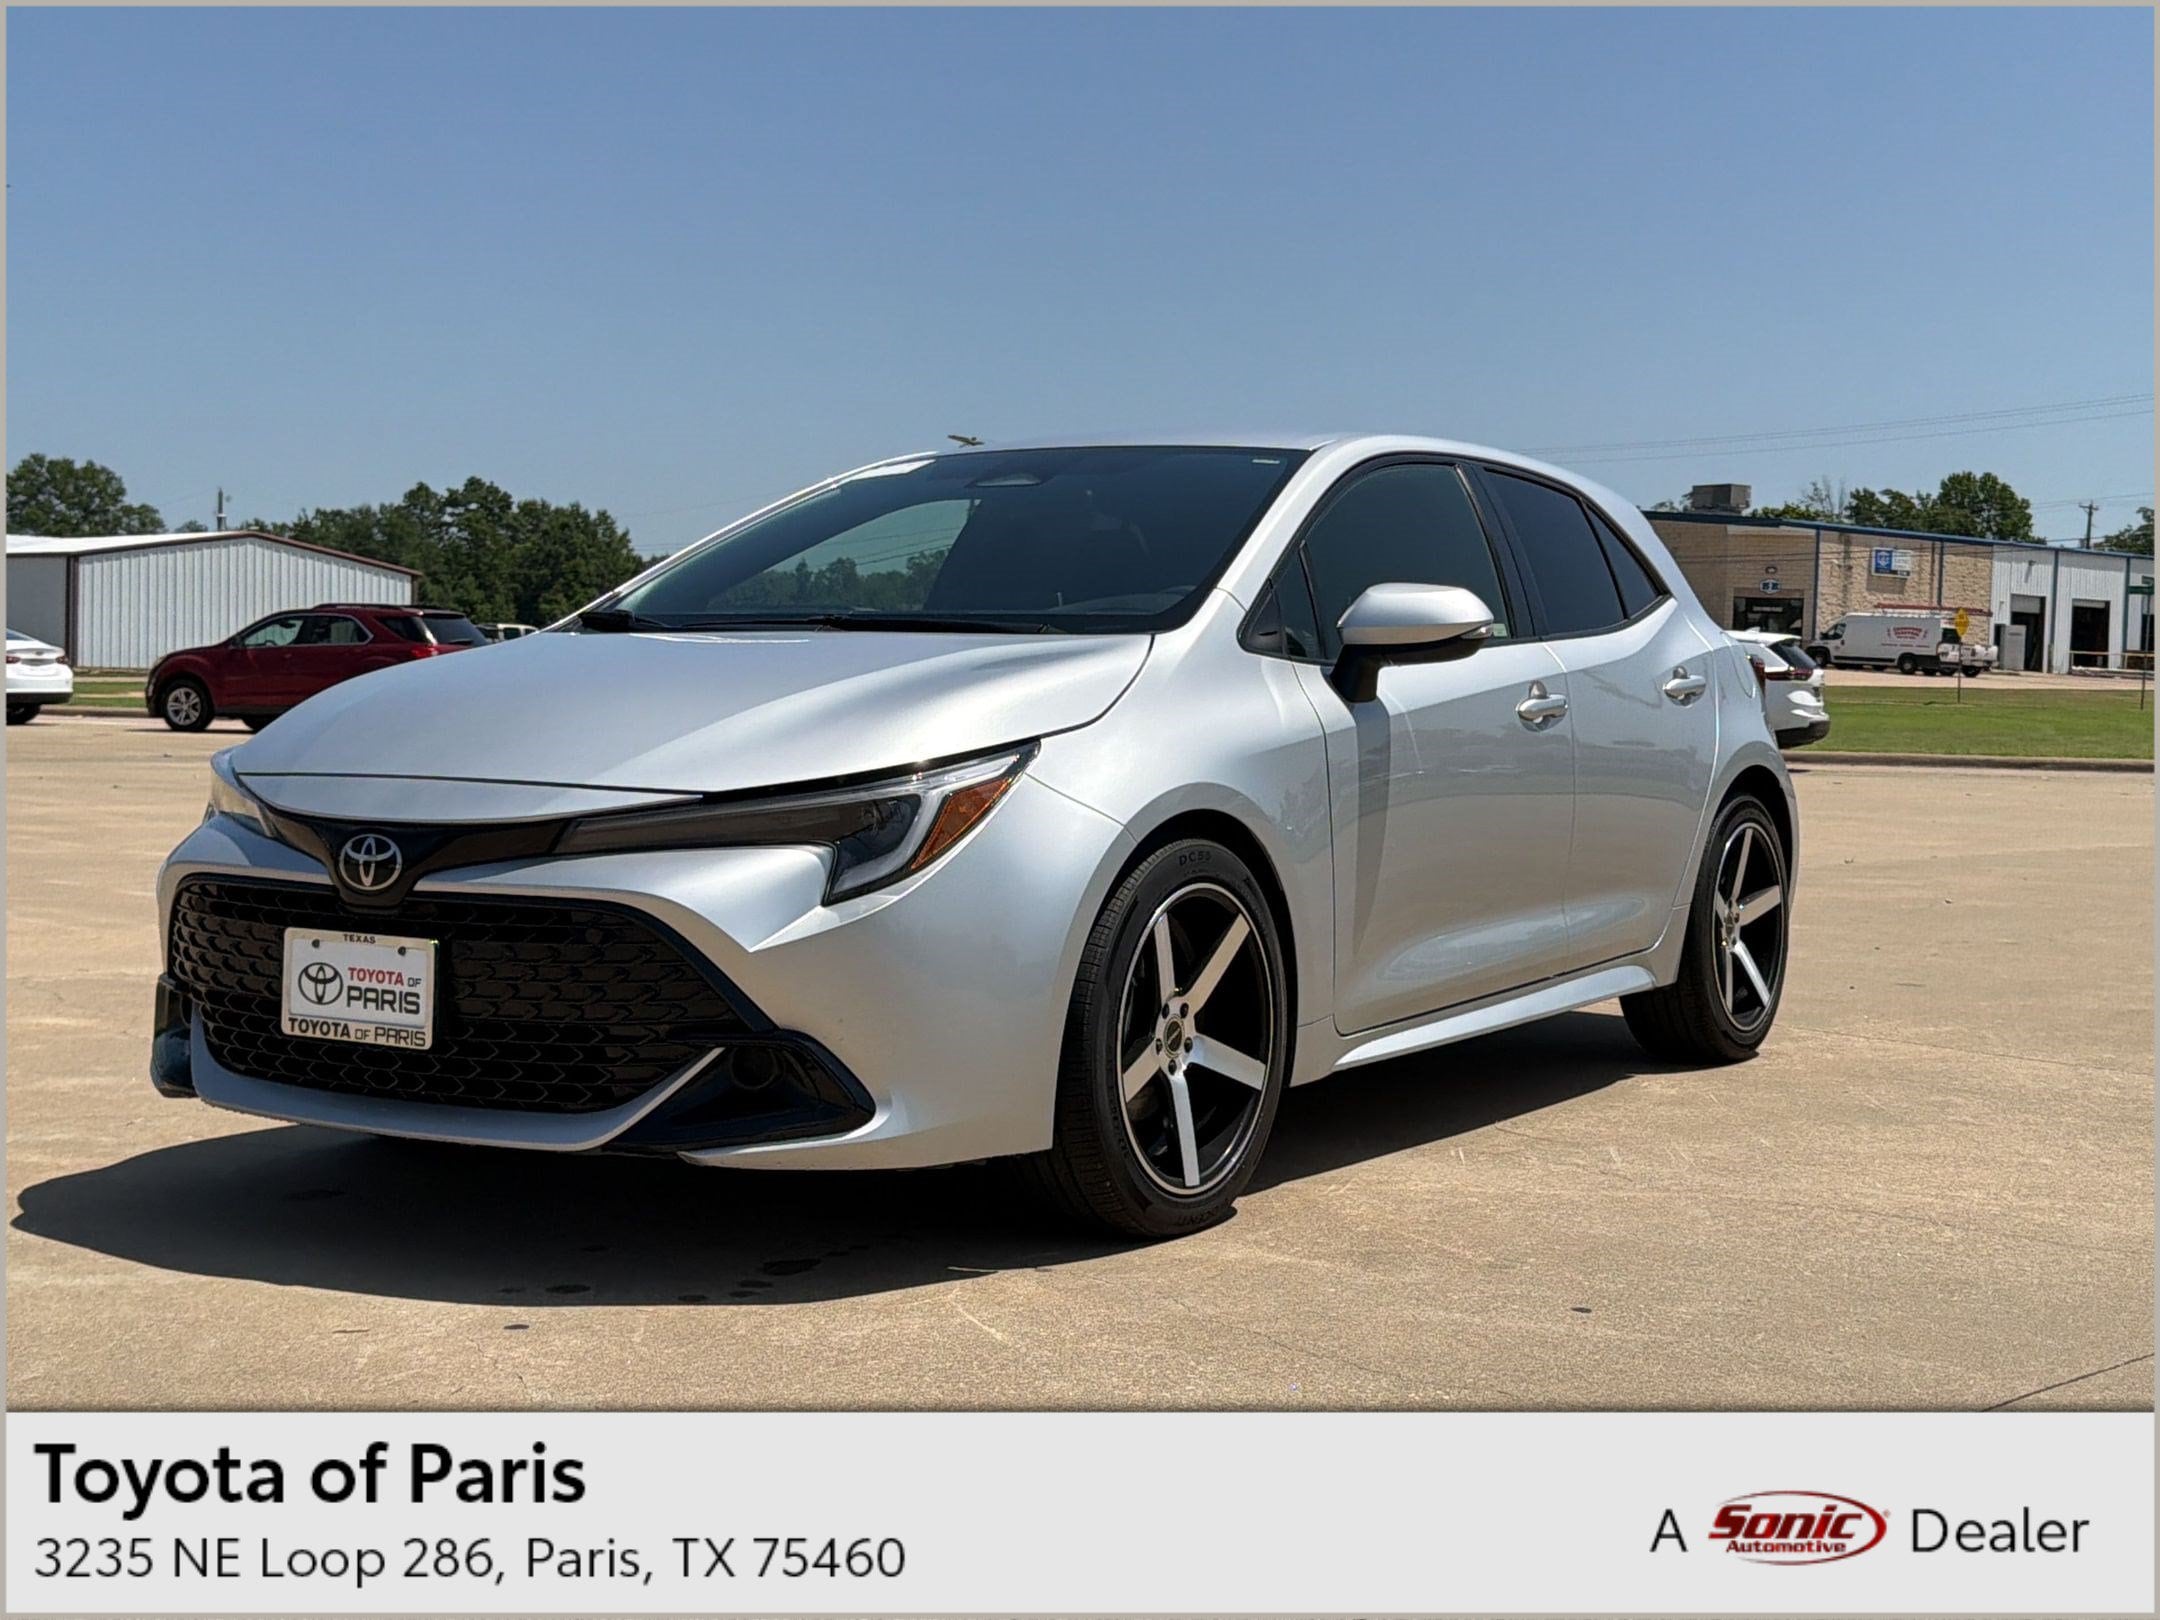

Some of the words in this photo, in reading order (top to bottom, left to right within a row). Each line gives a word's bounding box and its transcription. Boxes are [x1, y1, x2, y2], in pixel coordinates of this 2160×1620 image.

[342, 933, 376, 944] TEXAS
[348, 967, 404, 986] TOYOTA
[407, 977, 421, 987] OF
[346, 985, 420, 1014] PARIS
[288, 1017, 351, 1038] TOYOTA
[354, 1028, 371, 1040] OF
[374, 1026, 426, 1047] PARIS
